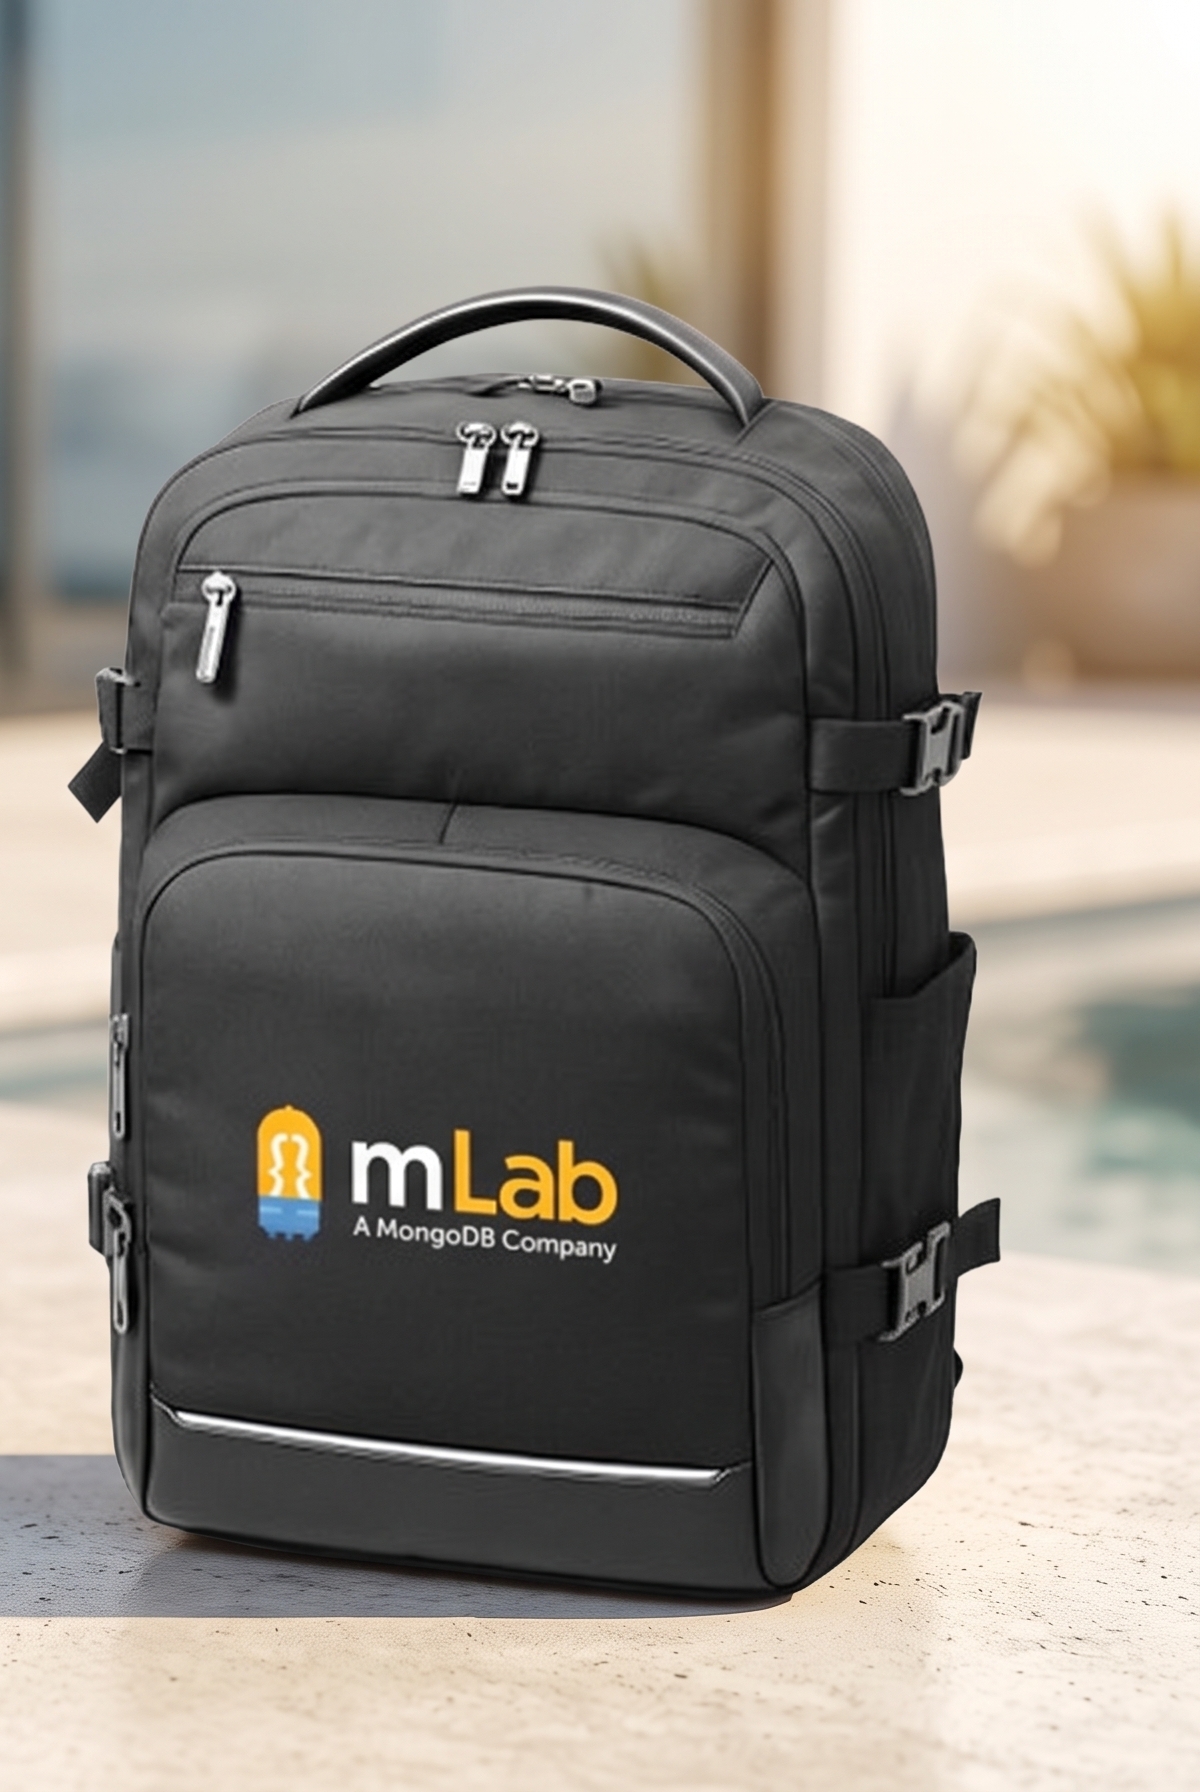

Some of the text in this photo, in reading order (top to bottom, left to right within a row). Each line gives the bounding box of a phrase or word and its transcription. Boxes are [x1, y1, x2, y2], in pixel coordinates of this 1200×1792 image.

[351, 1129, 617, 1225] mLab
[353, 1216, 617, 1263] A MongoDB Company
